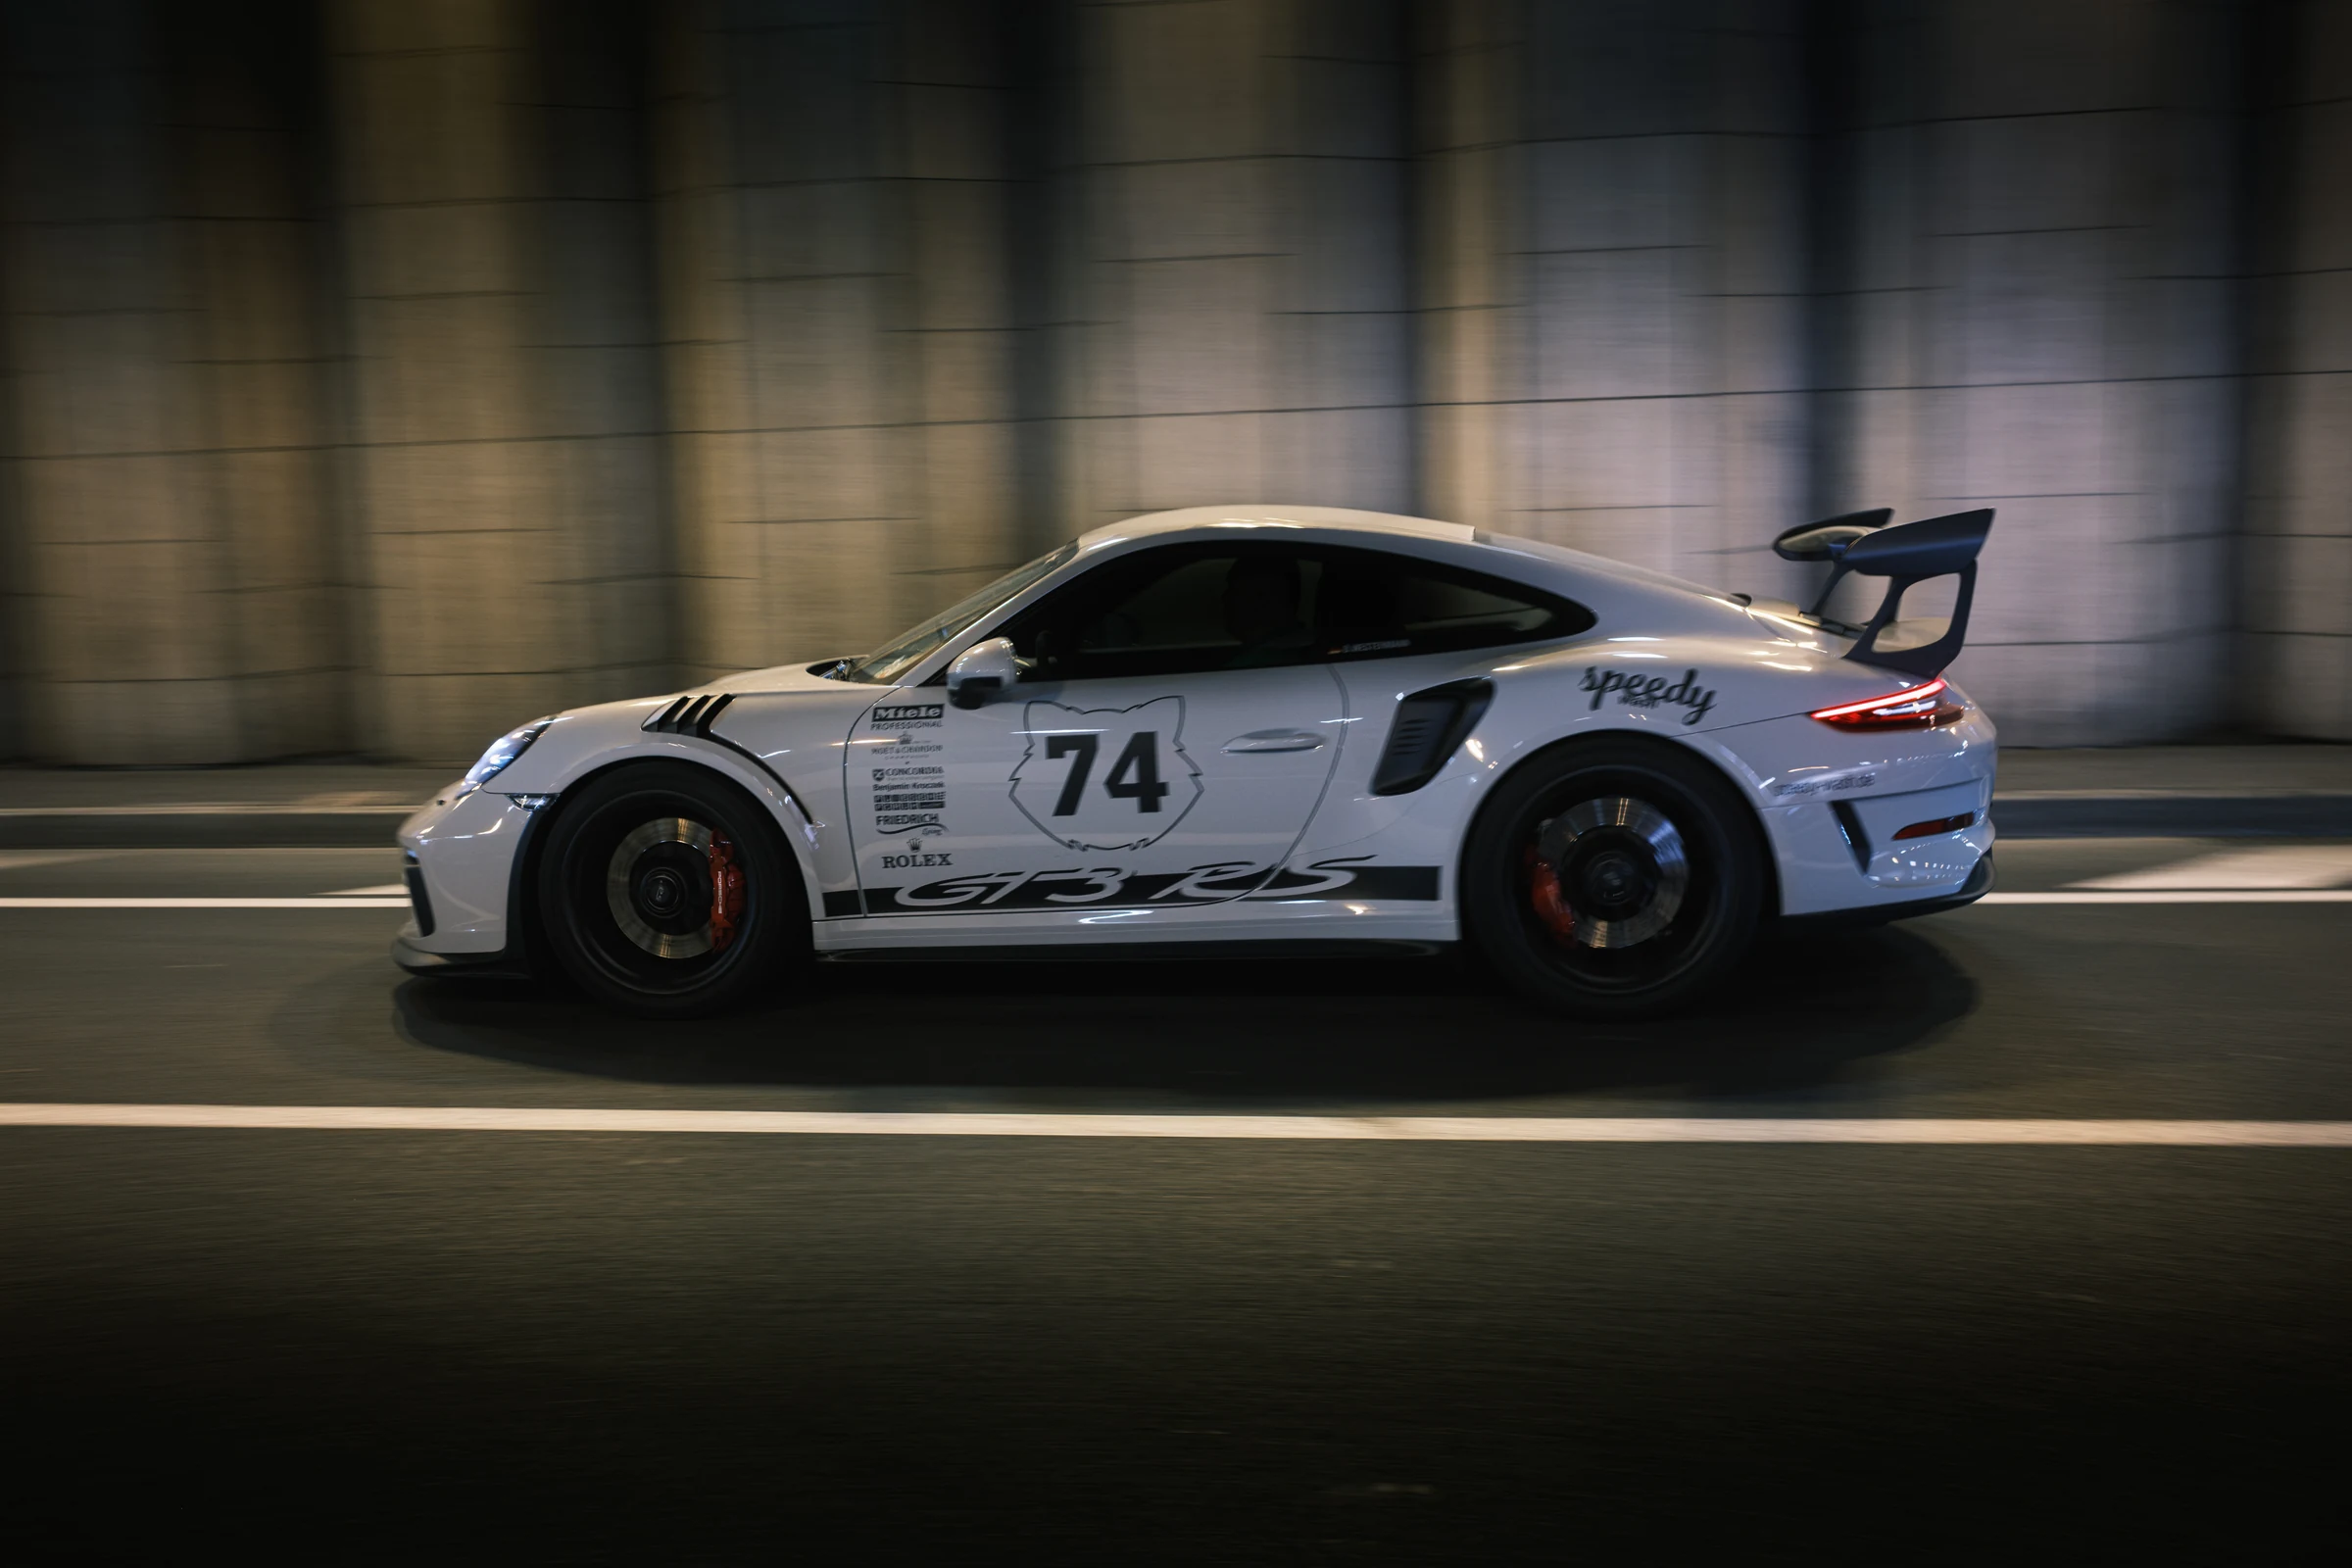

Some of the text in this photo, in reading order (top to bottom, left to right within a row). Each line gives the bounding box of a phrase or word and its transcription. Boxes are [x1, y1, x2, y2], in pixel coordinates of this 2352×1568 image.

[1578, 665, 1718, 726] speedy
[873, 706, 942, 720] Miele
[870, 720, 944, 730] PROFESSIONAL
[1045, 731, 1170, 816] 74
[876, 813, 939, 825] FRIEDRICH
[881, 854, 954, 868] ROLEX
[895, 855, 1378, 906] GT3 RS
